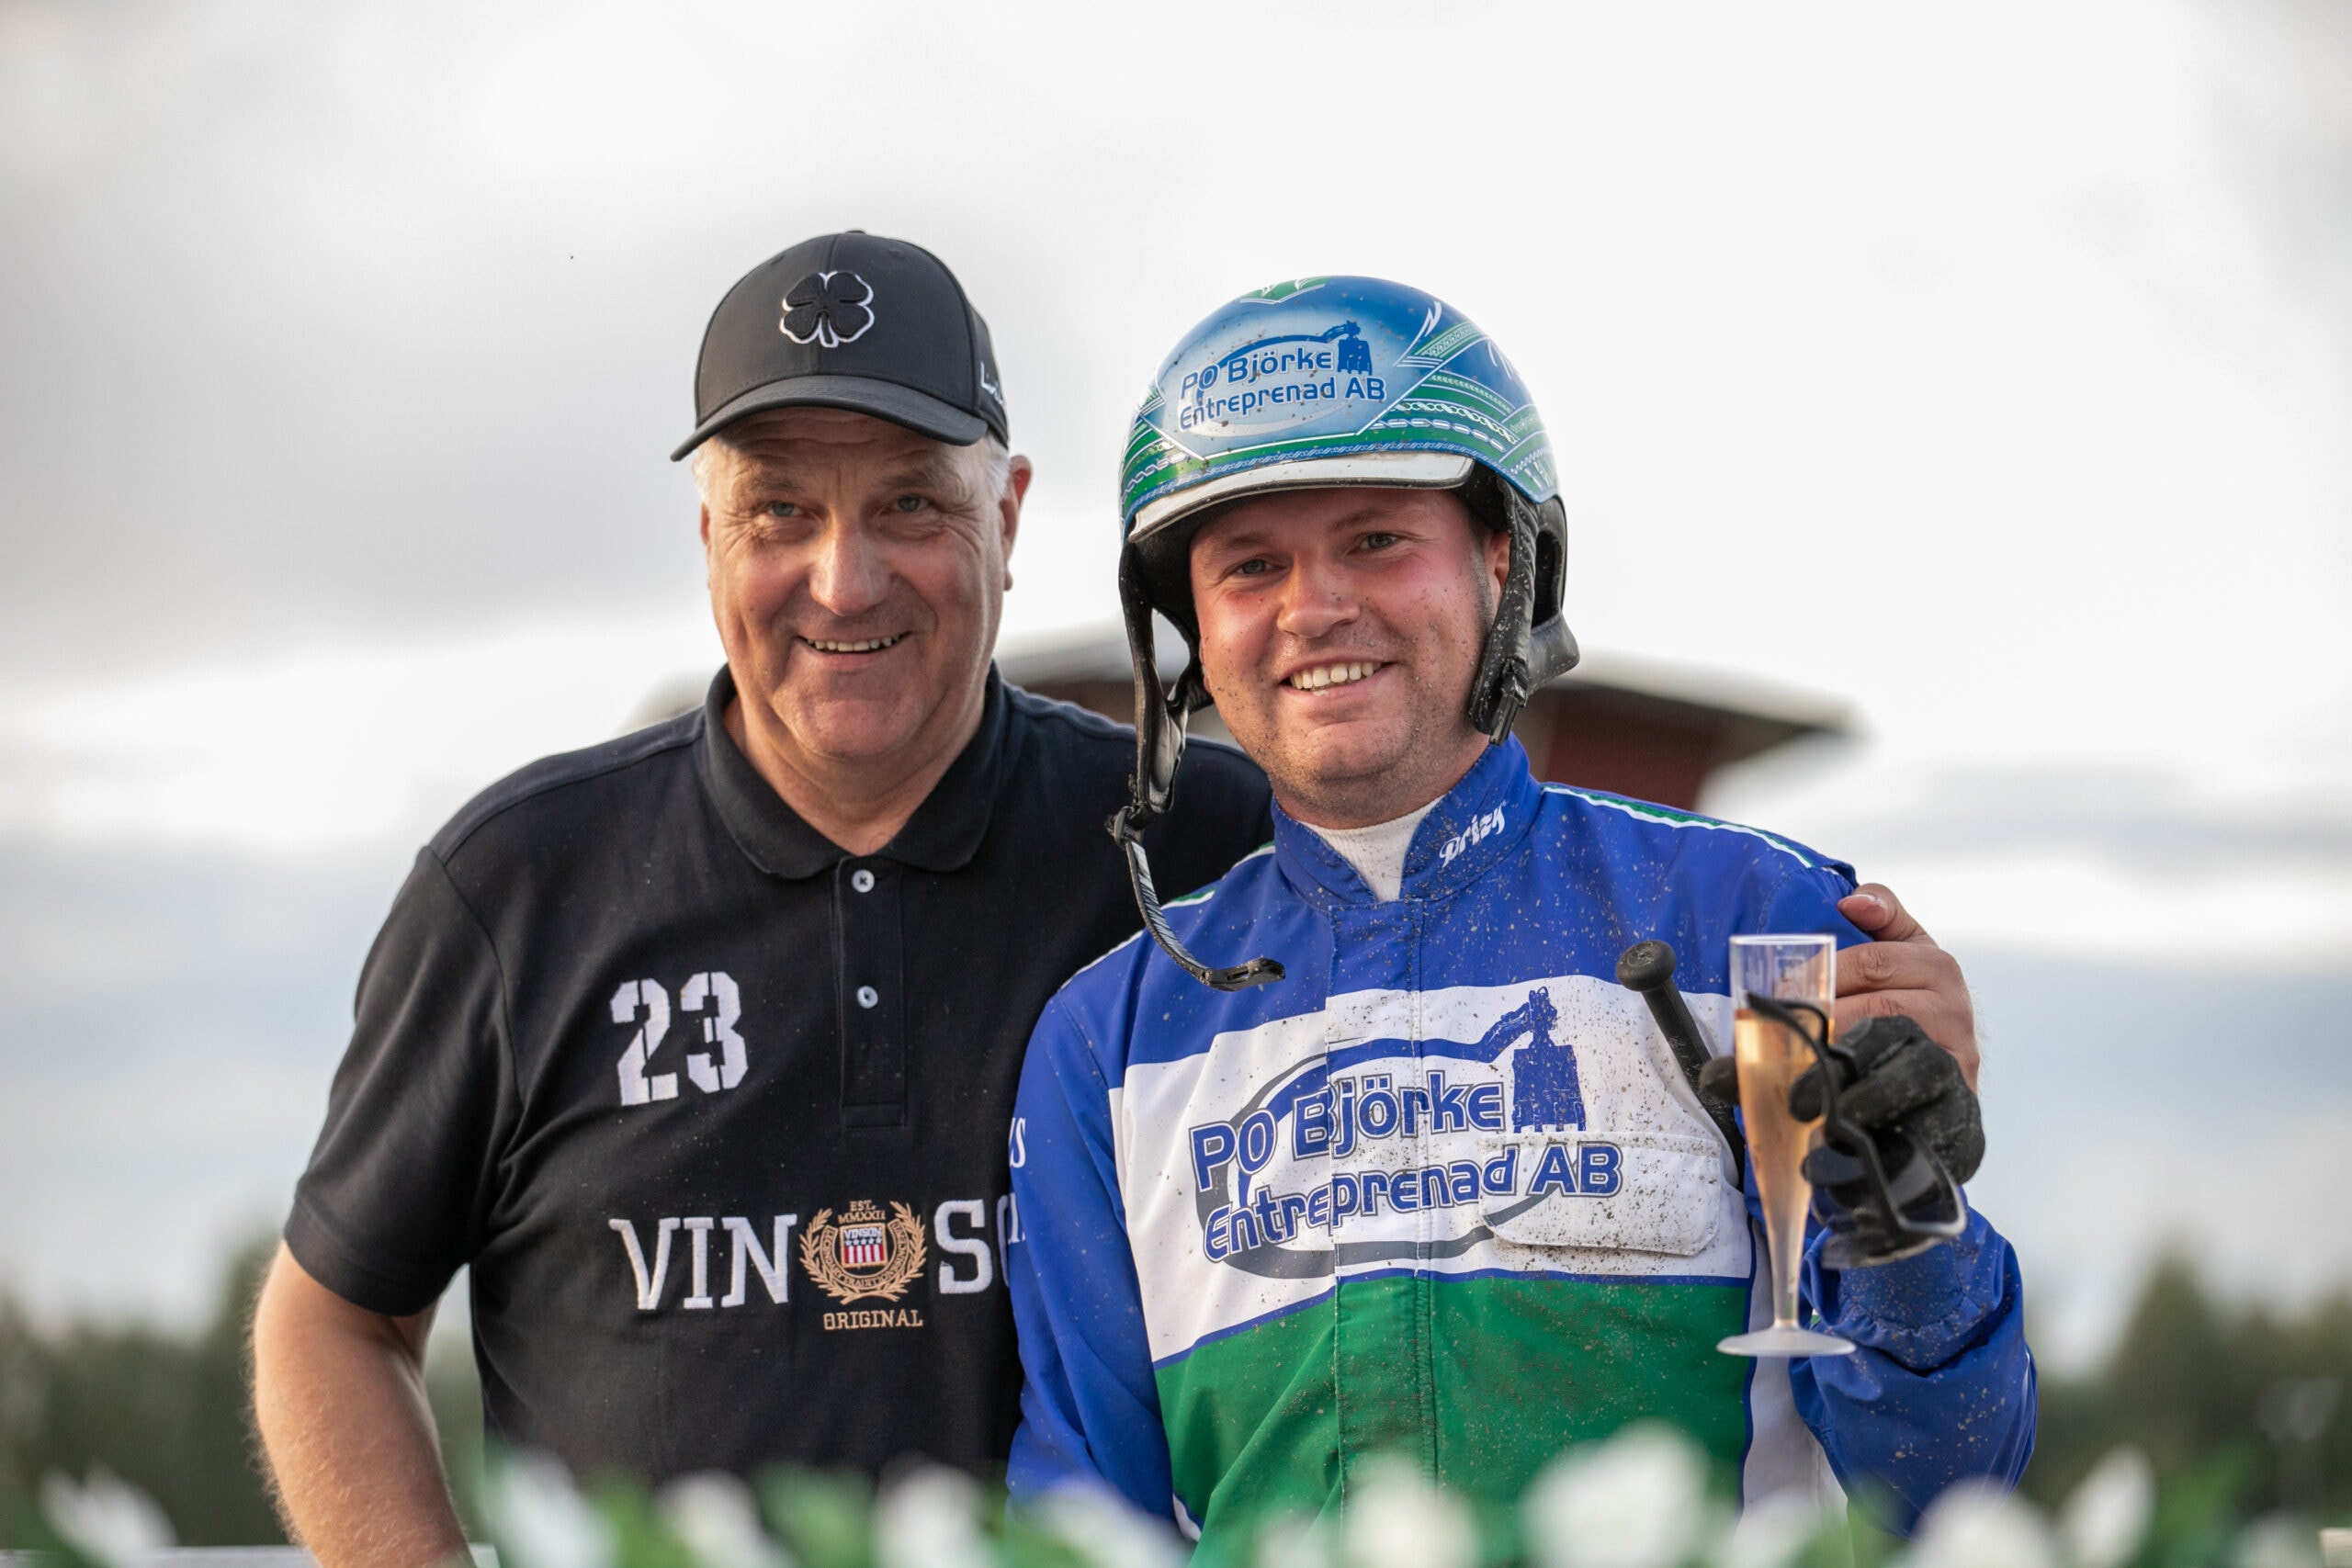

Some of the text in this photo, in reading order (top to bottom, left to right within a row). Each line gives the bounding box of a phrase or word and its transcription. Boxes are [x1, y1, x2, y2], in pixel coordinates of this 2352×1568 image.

[1180, 347, 1332, 400] PO Björke
[1180, 377, 1386, 430] Entreprenad AB
[610, 972, 748, 1105] 23
[1189, 1070, 1505, 1191] PO Björke
[1204, 1142, 1623, 1262] Entreprenad AB
[843, 1227, 882, 1239] VINSON
[823, 1309, 923, 1330] ORIGINAL
